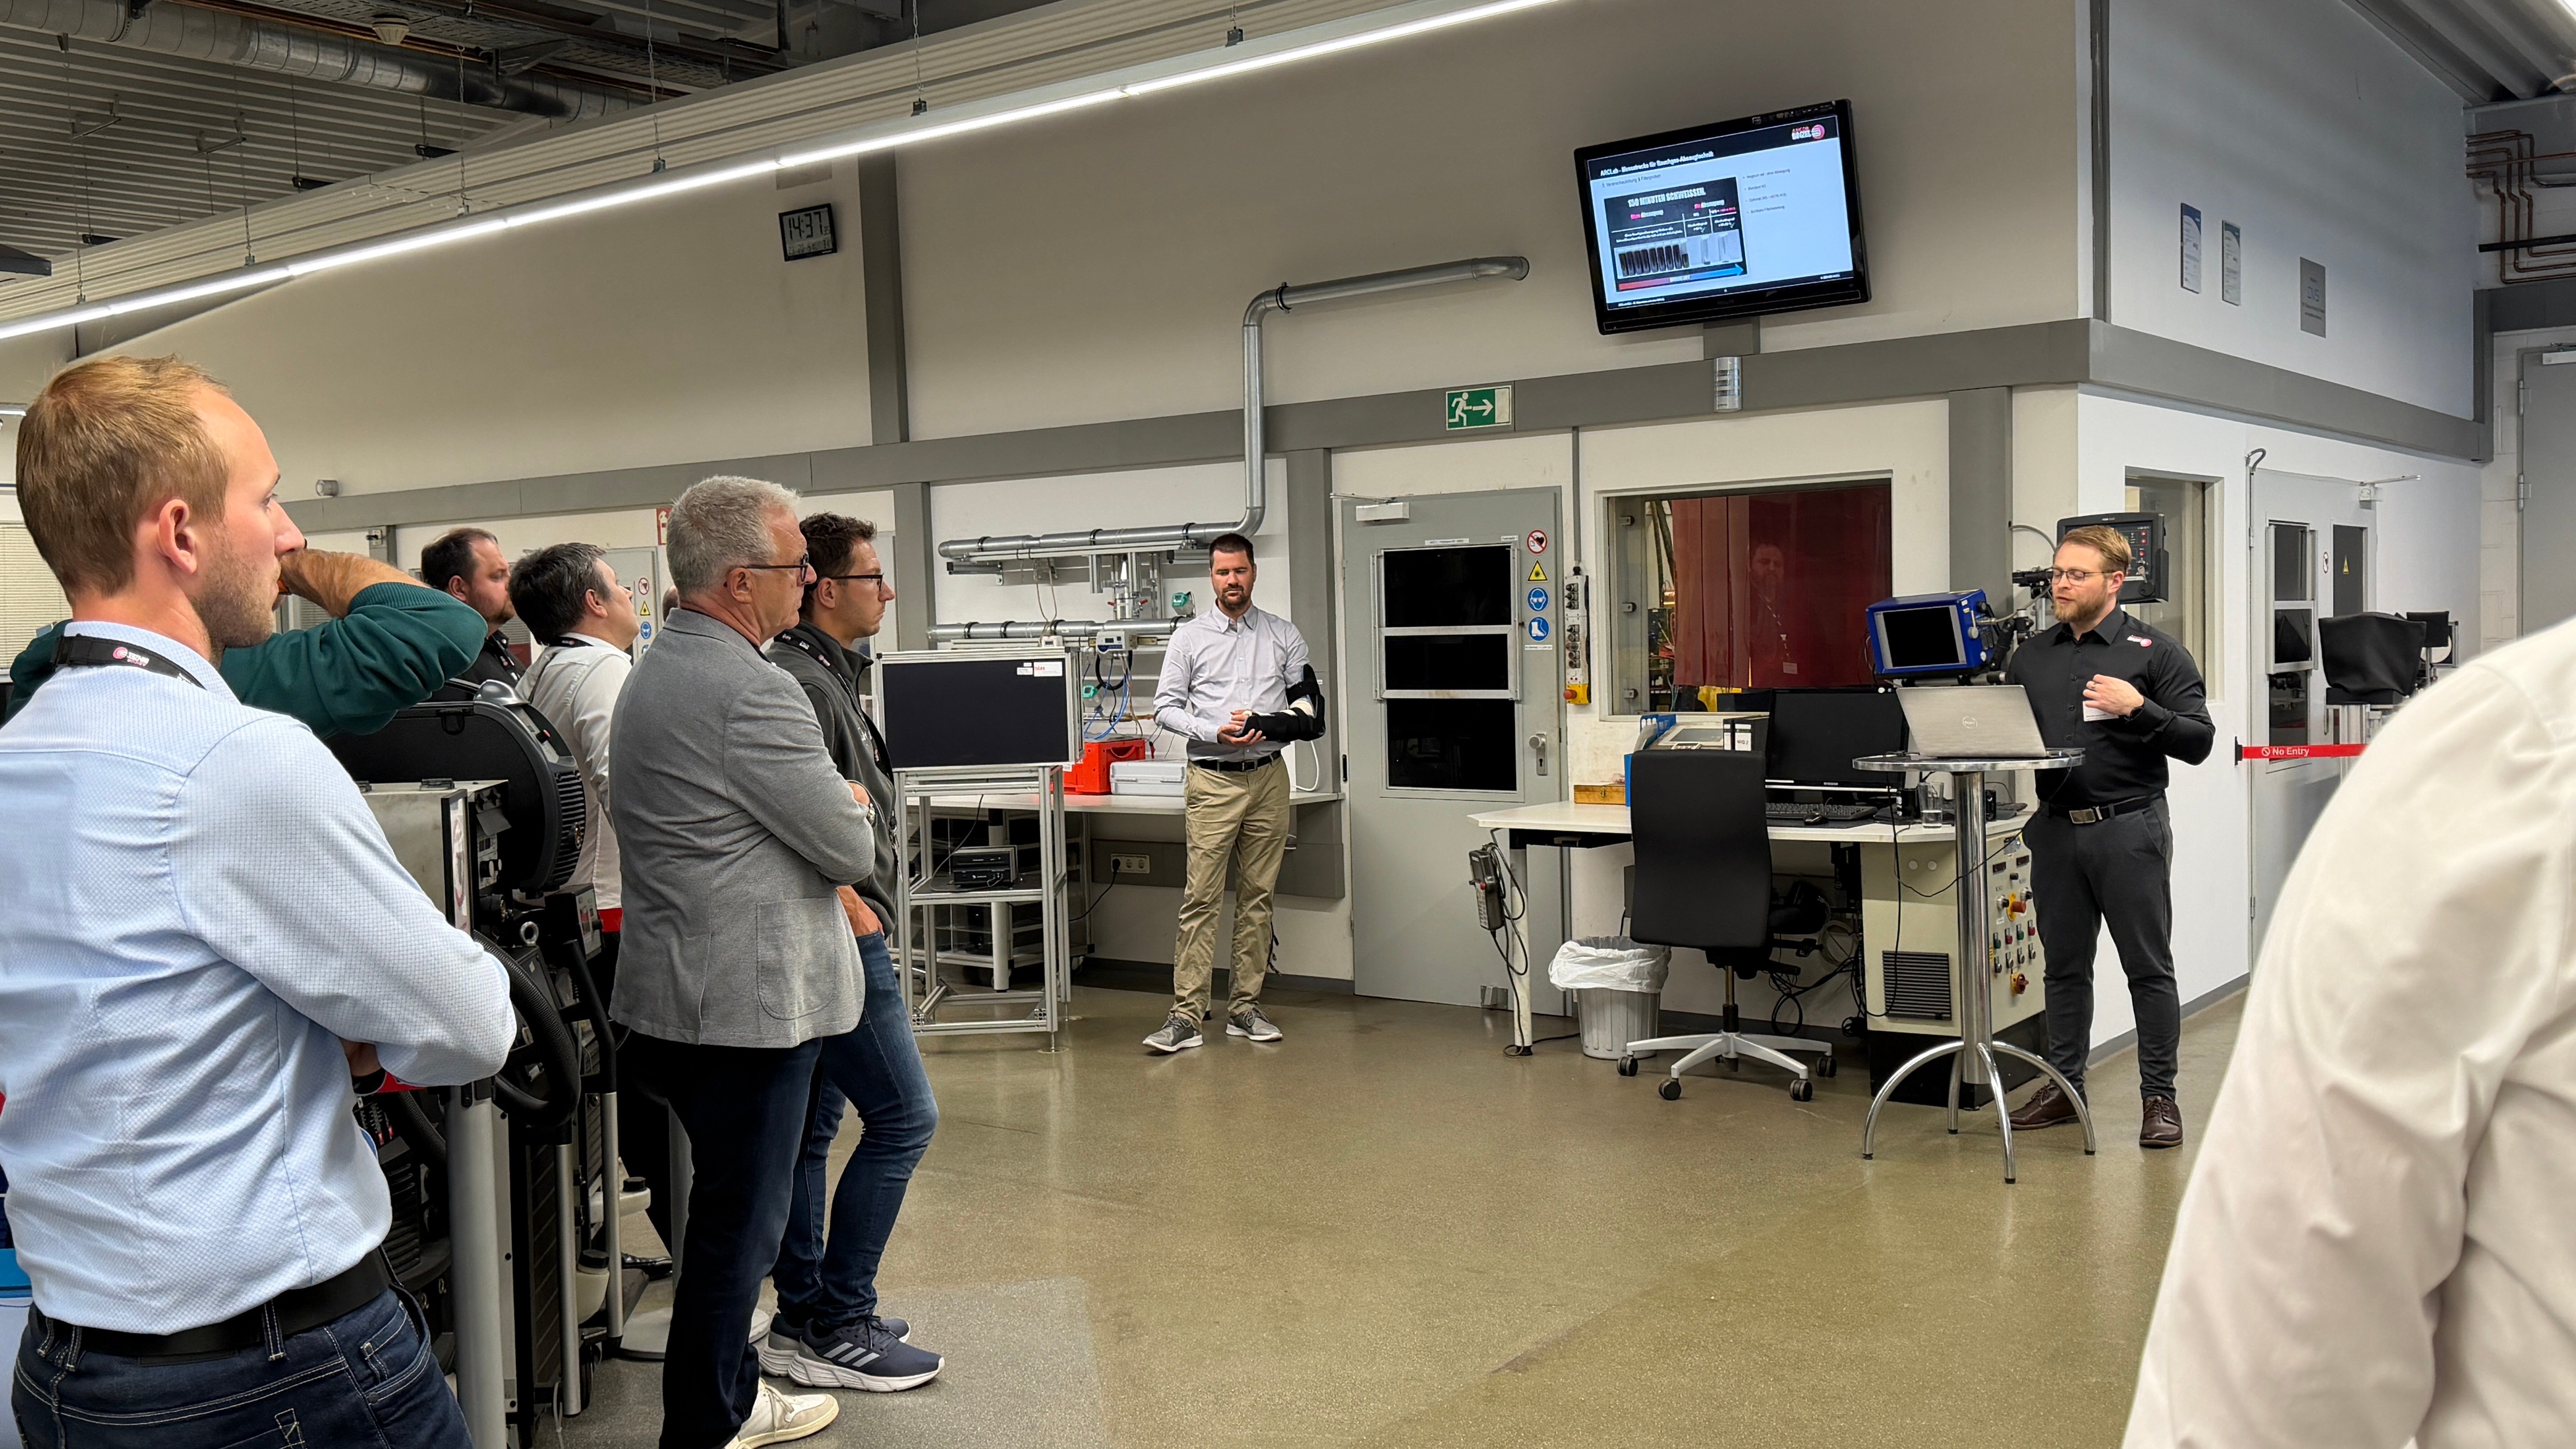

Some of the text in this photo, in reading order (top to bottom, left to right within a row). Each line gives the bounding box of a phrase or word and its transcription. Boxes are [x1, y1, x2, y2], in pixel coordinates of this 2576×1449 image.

[789, 211, 823, 240] 14:37
[2272, 747, 2309, 757] No Entry
